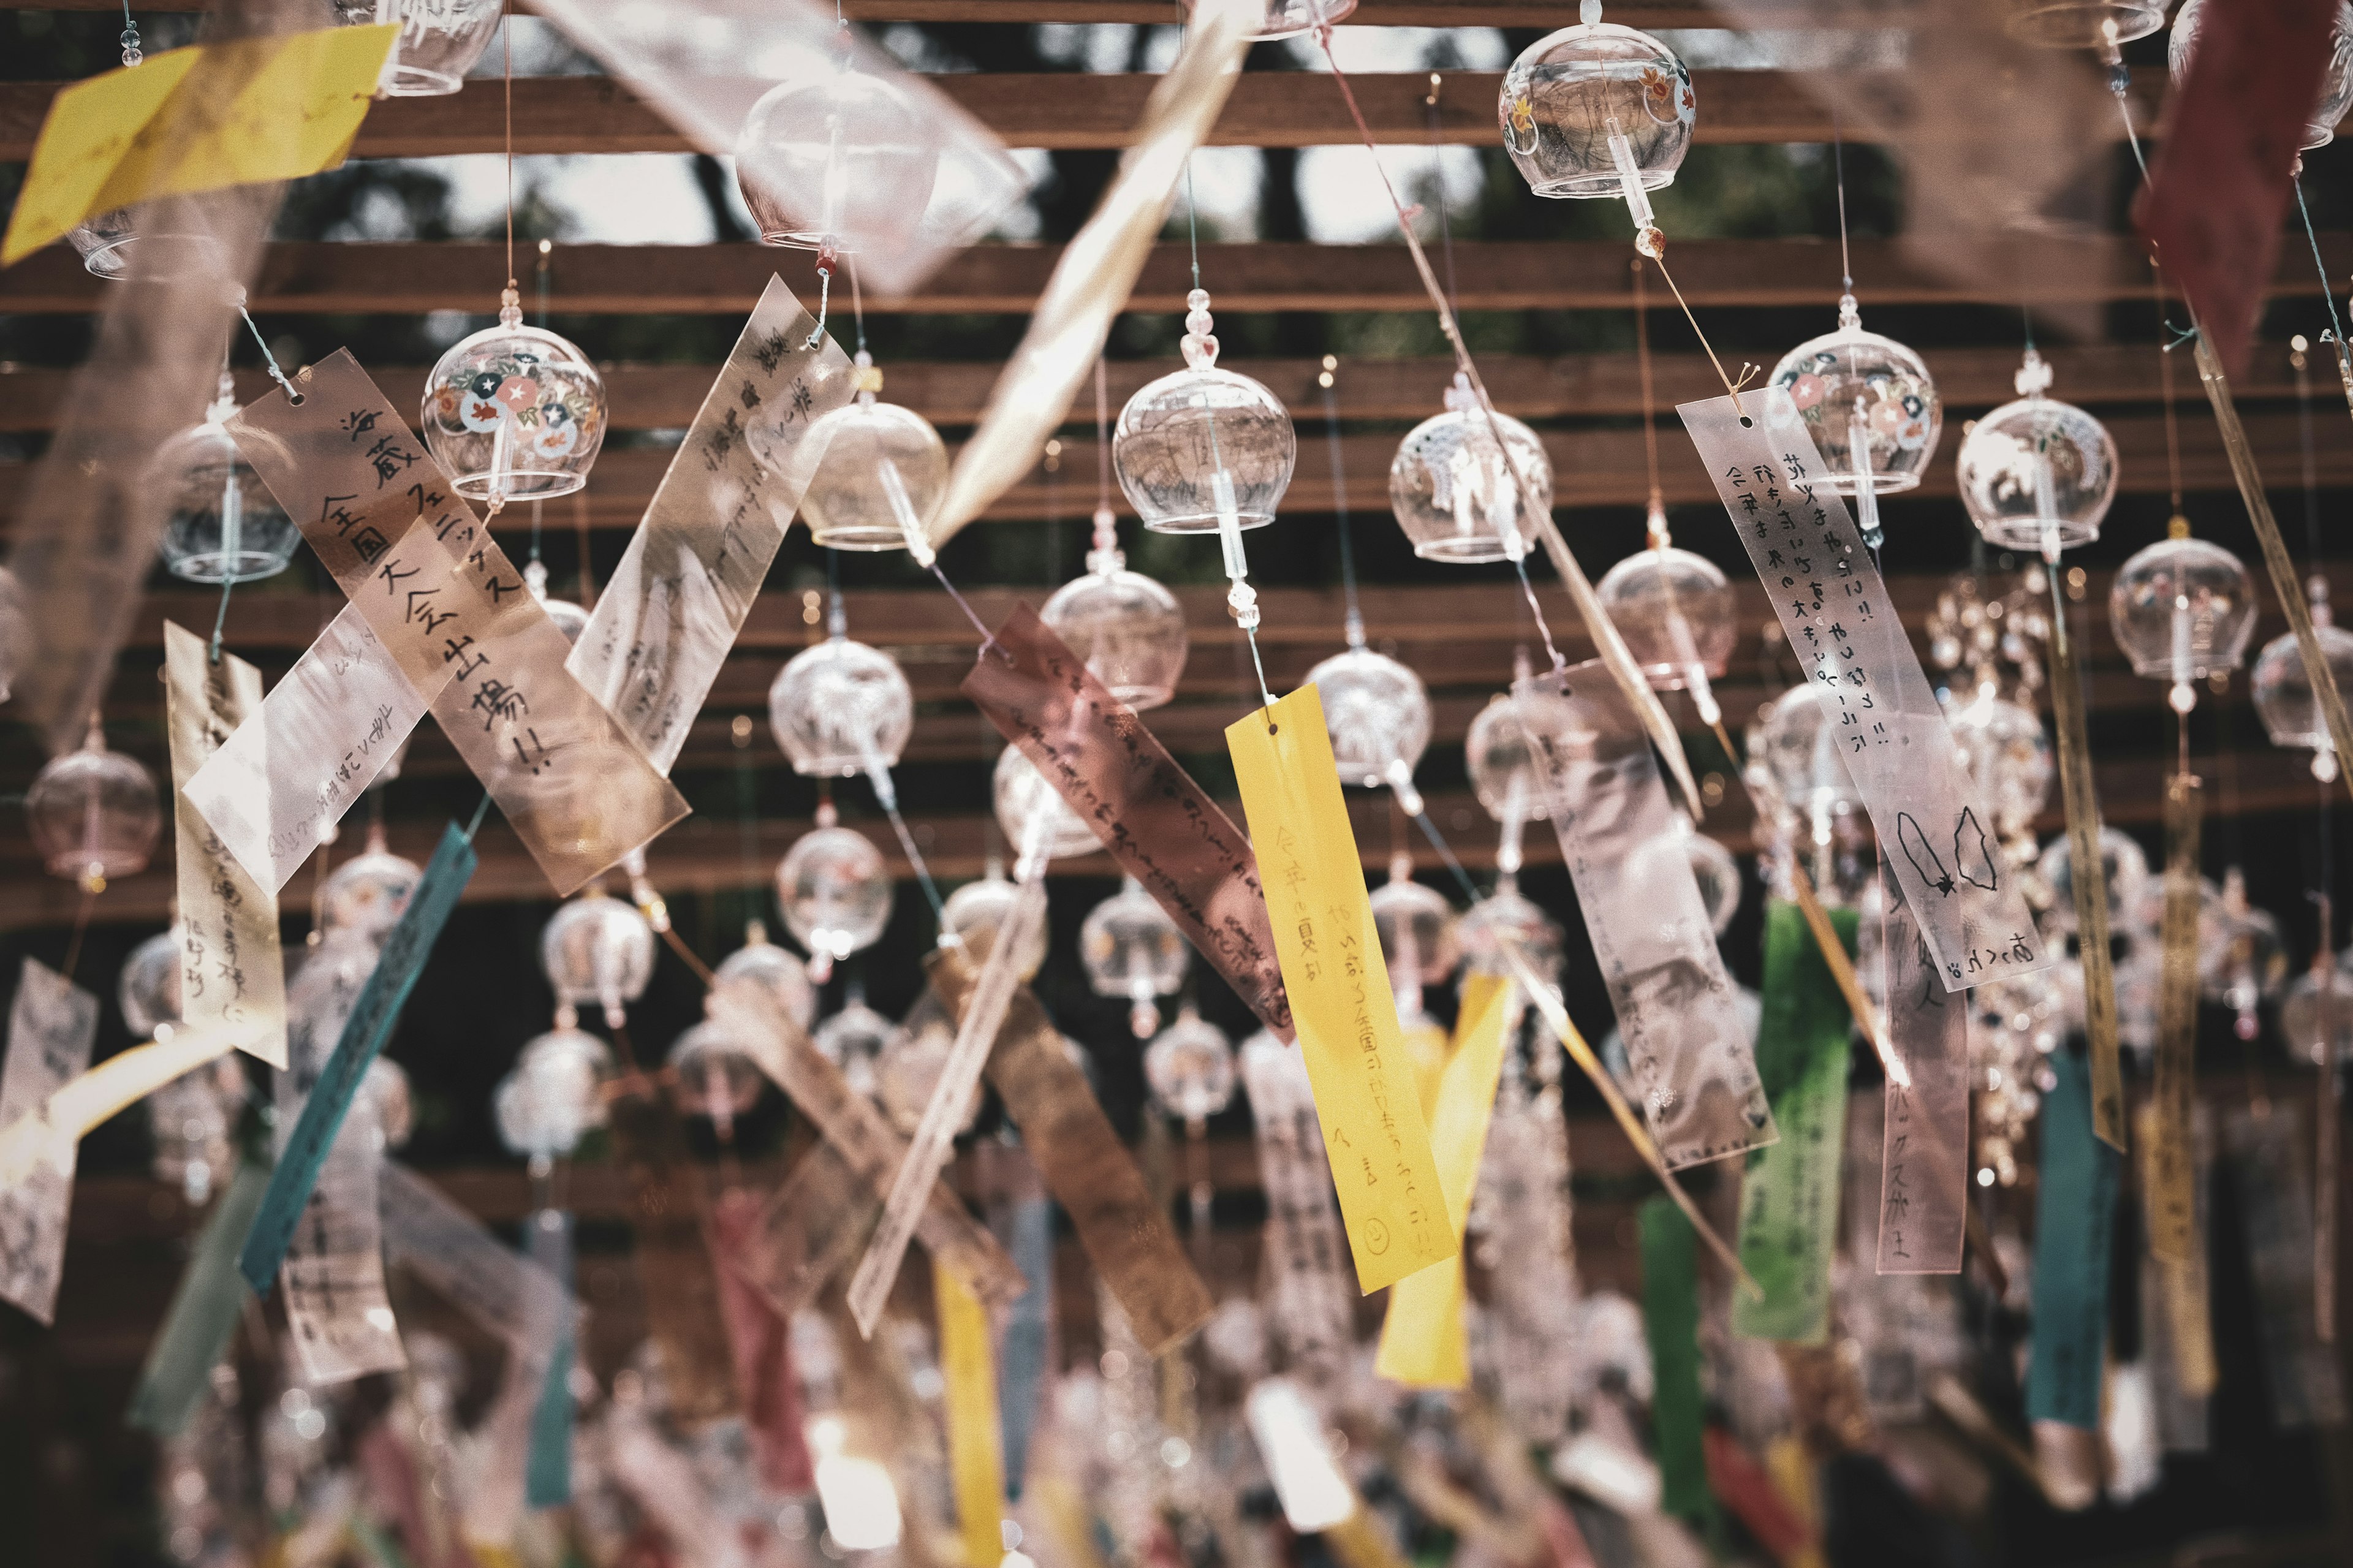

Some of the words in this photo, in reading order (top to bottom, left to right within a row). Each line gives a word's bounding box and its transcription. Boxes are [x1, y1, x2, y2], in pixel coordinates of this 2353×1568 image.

[339, 408, 522, 604] 海蔵フェニックス
